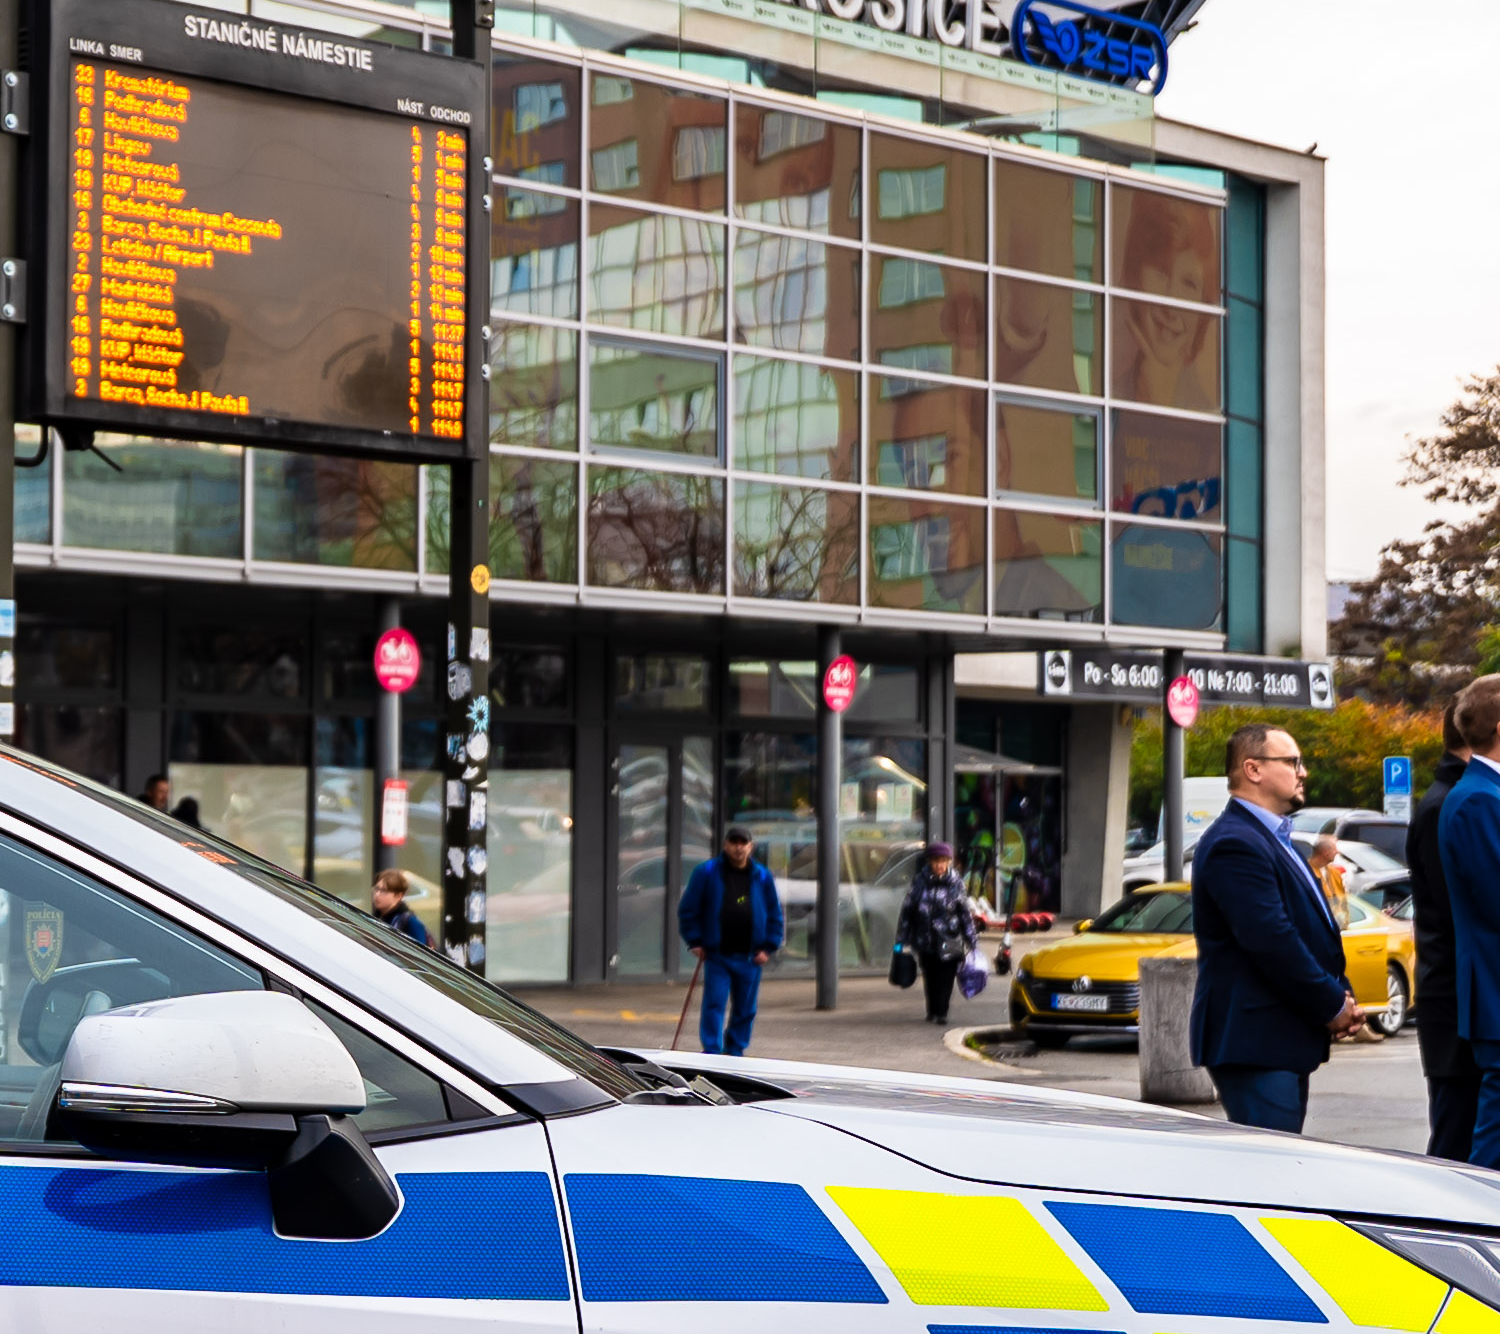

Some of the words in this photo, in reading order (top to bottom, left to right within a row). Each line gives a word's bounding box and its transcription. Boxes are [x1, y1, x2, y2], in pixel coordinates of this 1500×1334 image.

[69, 37, 105, 55] LINKA
[109, 43, 144, 62] SMER
[184, 14, 278, 52] STANIČNÉ
[282, 29, 374, 72] NÁMESTIE
[1082, 28, 1158, 80] ŽSR
[430, 105, 471, 124] ODCHOD
[1084, 662, 1101, 685] Po
[1111, 663, 1128, 686] So
[1129, 664, 1158, 687] 6:00
[1226, 671, 1252, 693] 7:00
[1263, 673, 1299, 696] 21:00
[26, 907, 61, 920] POLÍCIA
